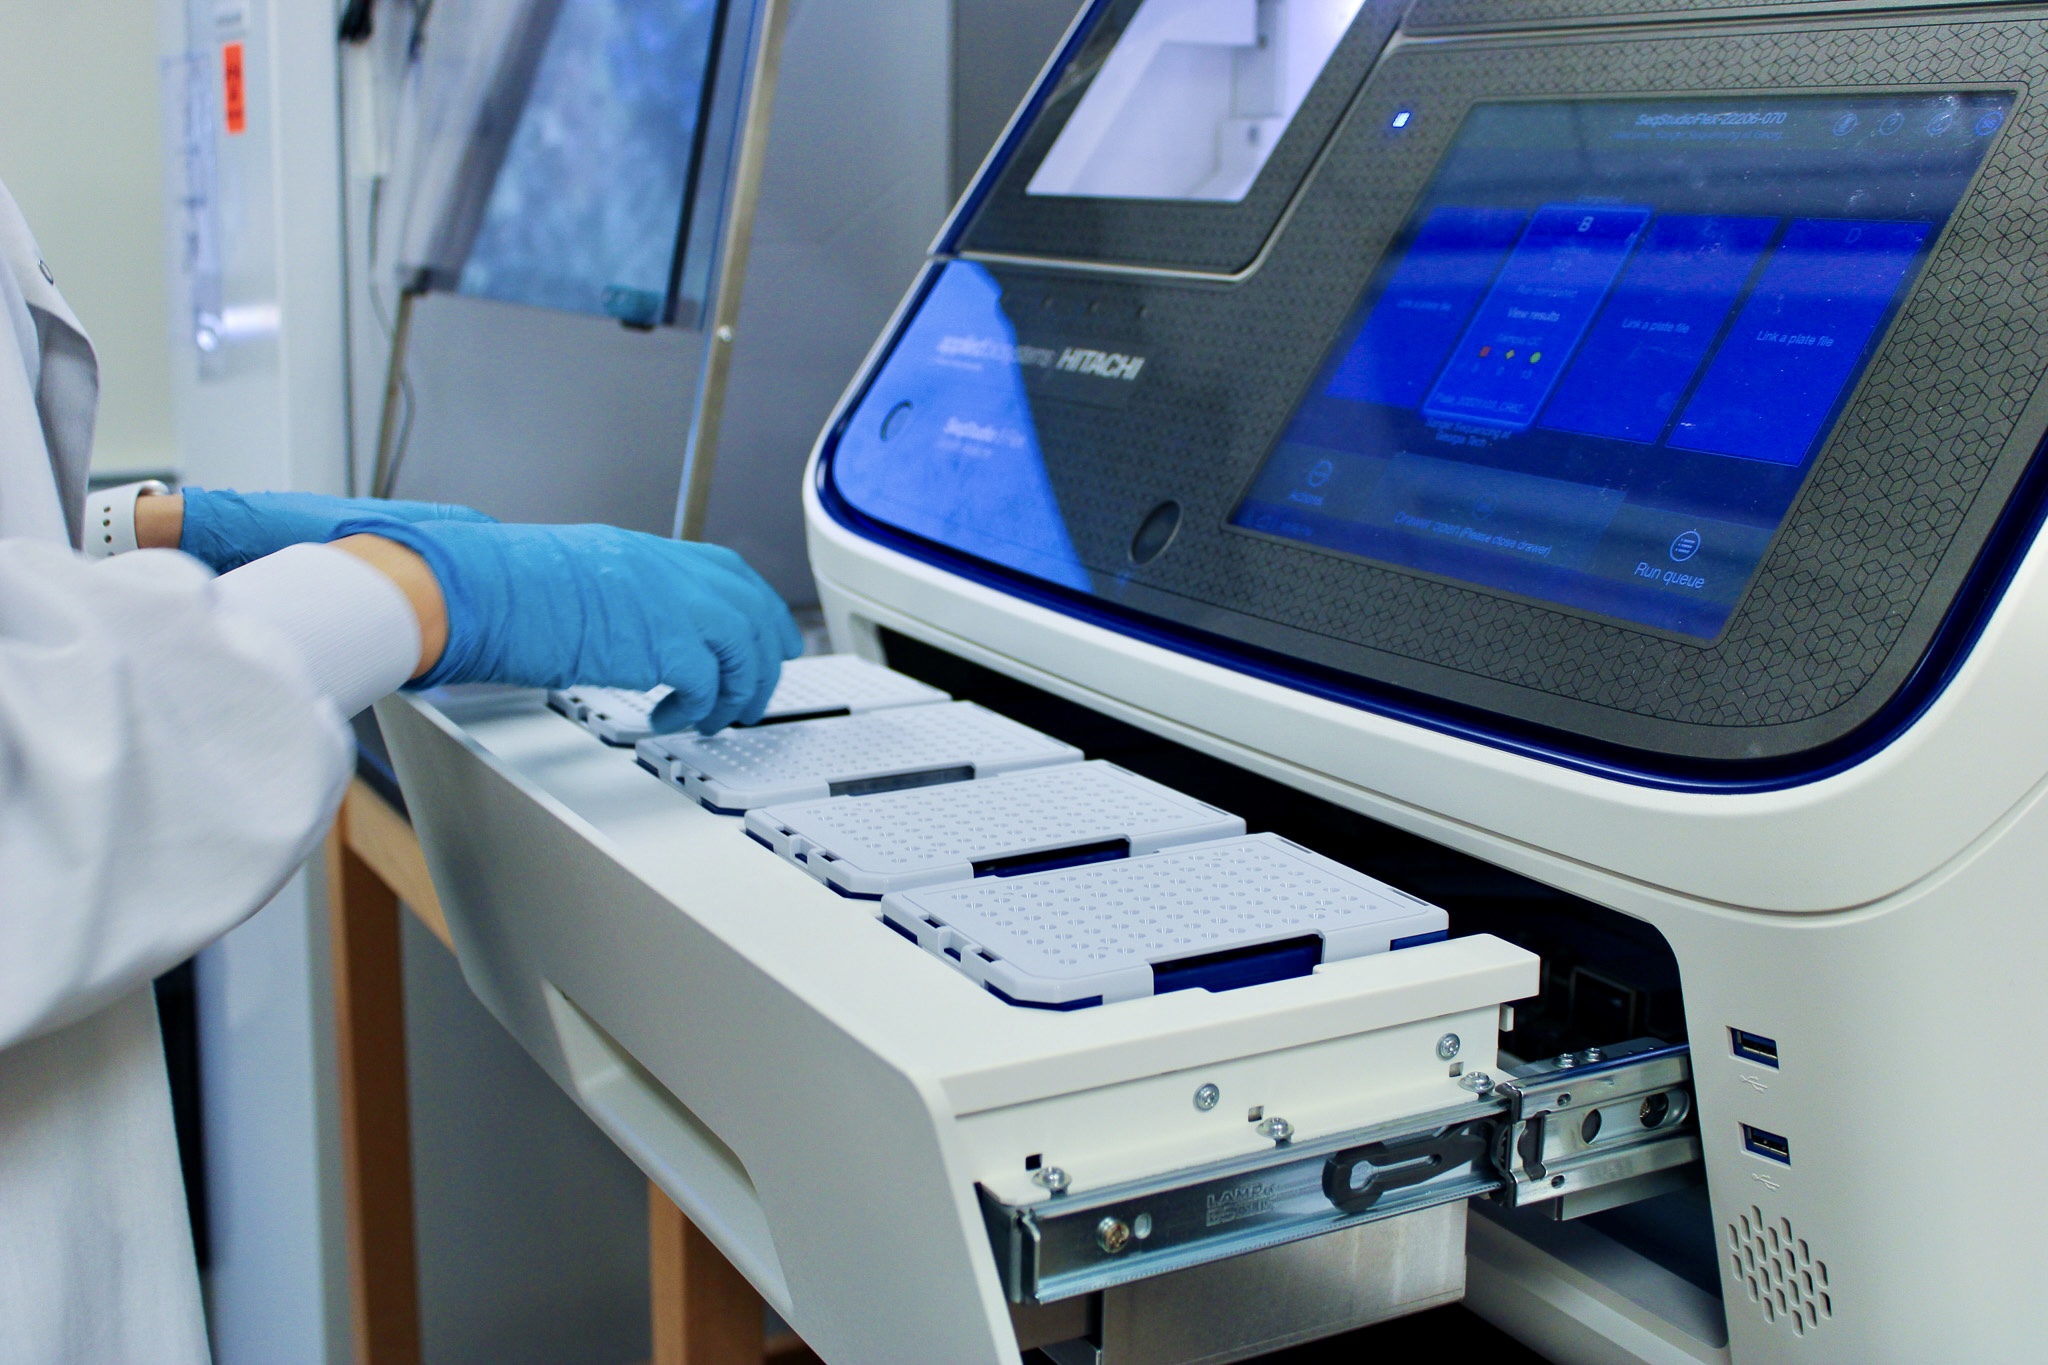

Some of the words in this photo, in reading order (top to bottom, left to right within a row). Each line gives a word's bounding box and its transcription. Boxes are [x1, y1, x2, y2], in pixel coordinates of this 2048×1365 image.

[1577, 215, 1595, 233] B
[1844, 227, 1862, 243] D
[1648, 321, 1674, 333] plate
[1756, 330, 1778, 343] Link
[1779, 335, 1787, 344] a
[1787, 333, 1816, 347] plate
[1816, 335, 1835, 348] file
[1056, 347, 1145, 381] HITACHI
[1432, 520, 1460, 538] open
[1491, 535, 1517, 549] close
[1516, 538, 1553, 558] drawer)
[1634, 561, 1661, 580] Run
[1662, 570, 1705, 589] queue
